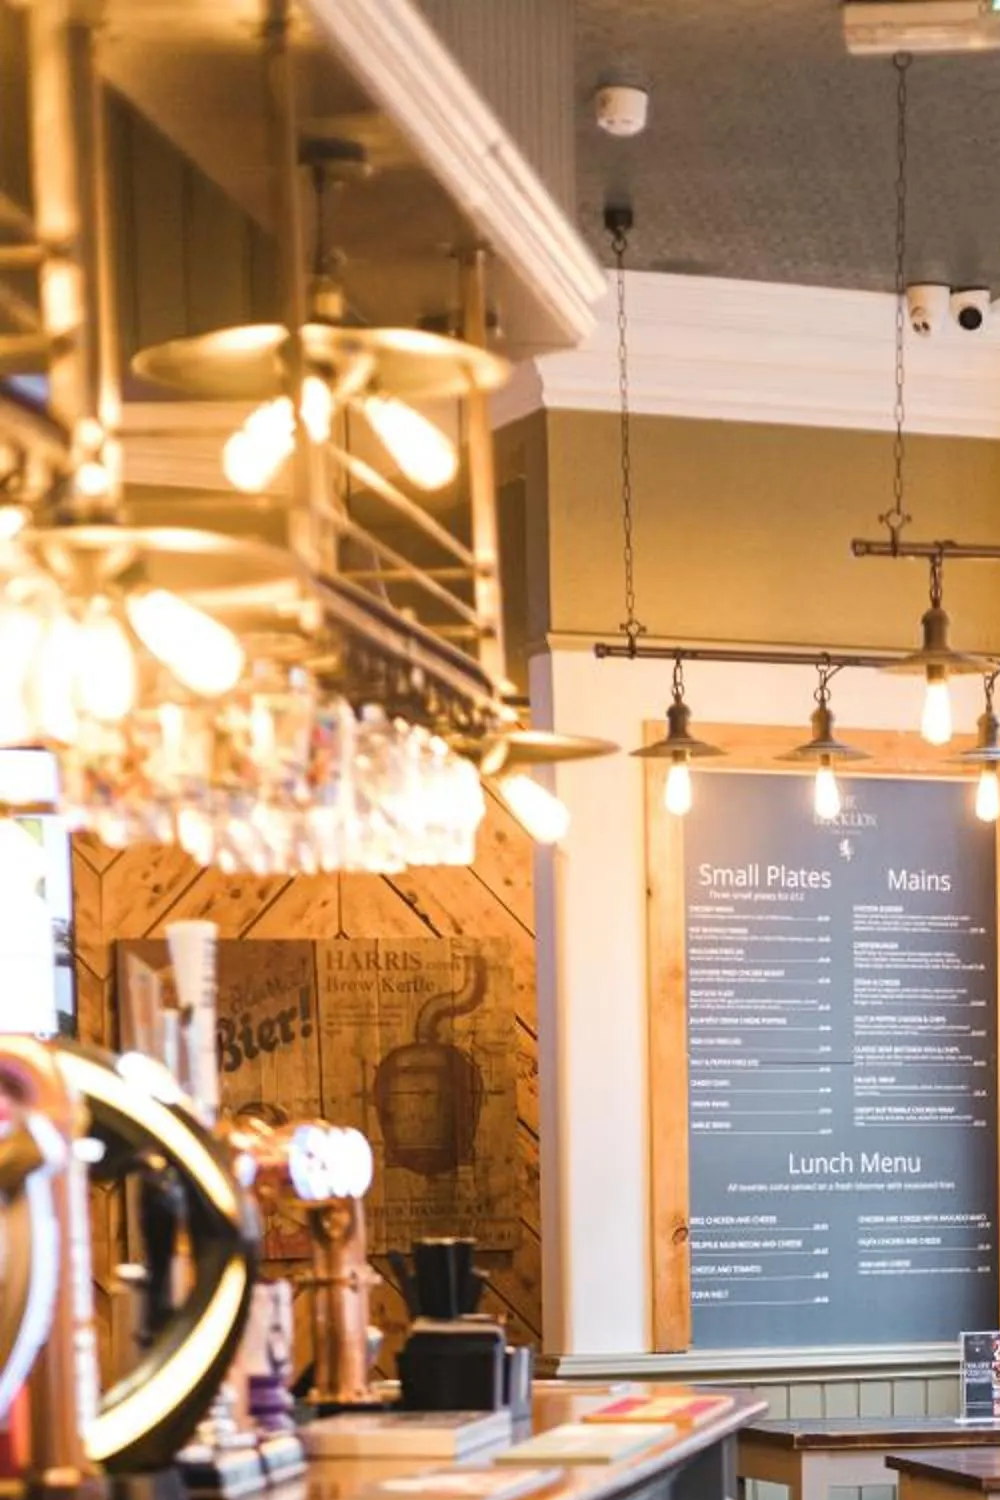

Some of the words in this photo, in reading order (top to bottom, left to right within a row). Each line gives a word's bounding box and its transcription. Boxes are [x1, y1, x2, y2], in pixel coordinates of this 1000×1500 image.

[699, 863, 759, 886] Small
[767, 864, 832, 888] Plates
[888, 868, 952, 891] Mains
[325, 950, 423, 972] HARRIS
[325, 976, 375, 993] Brew
[381, 974, 437, 994] Kettle
[789, 1152, 853, 1174] Lunch
[861, 1152, 922, 1173] Menu
